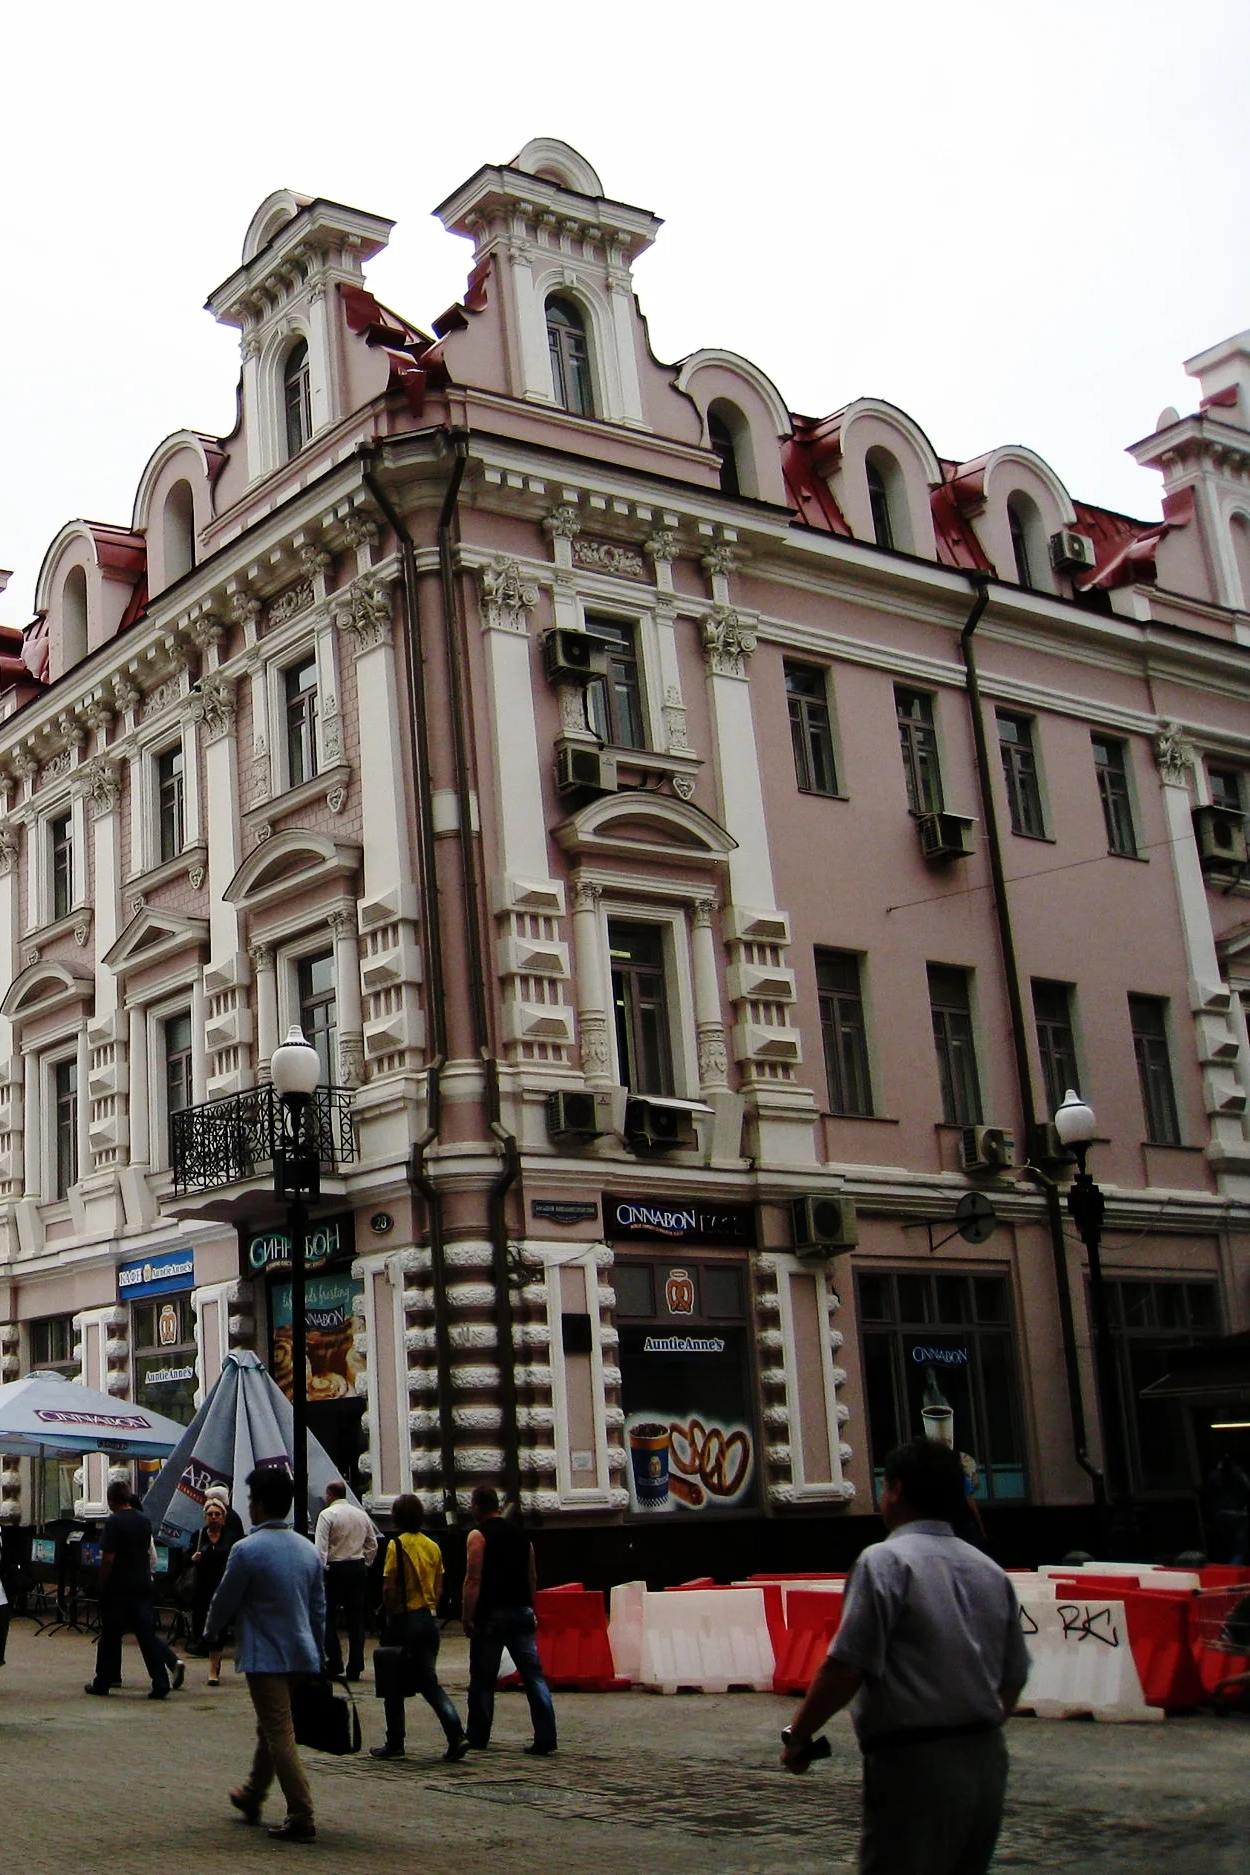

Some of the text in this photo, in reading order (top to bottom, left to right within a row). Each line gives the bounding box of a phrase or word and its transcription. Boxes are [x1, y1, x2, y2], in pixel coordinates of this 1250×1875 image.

[374, 1215, 387, 1229] 28
[616, 1204, 696, 1230] CINNABON
[250, 1223, 340, 1269] СИННБОН
[912, 1345, 968, 1364] CINNABON
[38, 1410, 150, 1428] CINNABON
